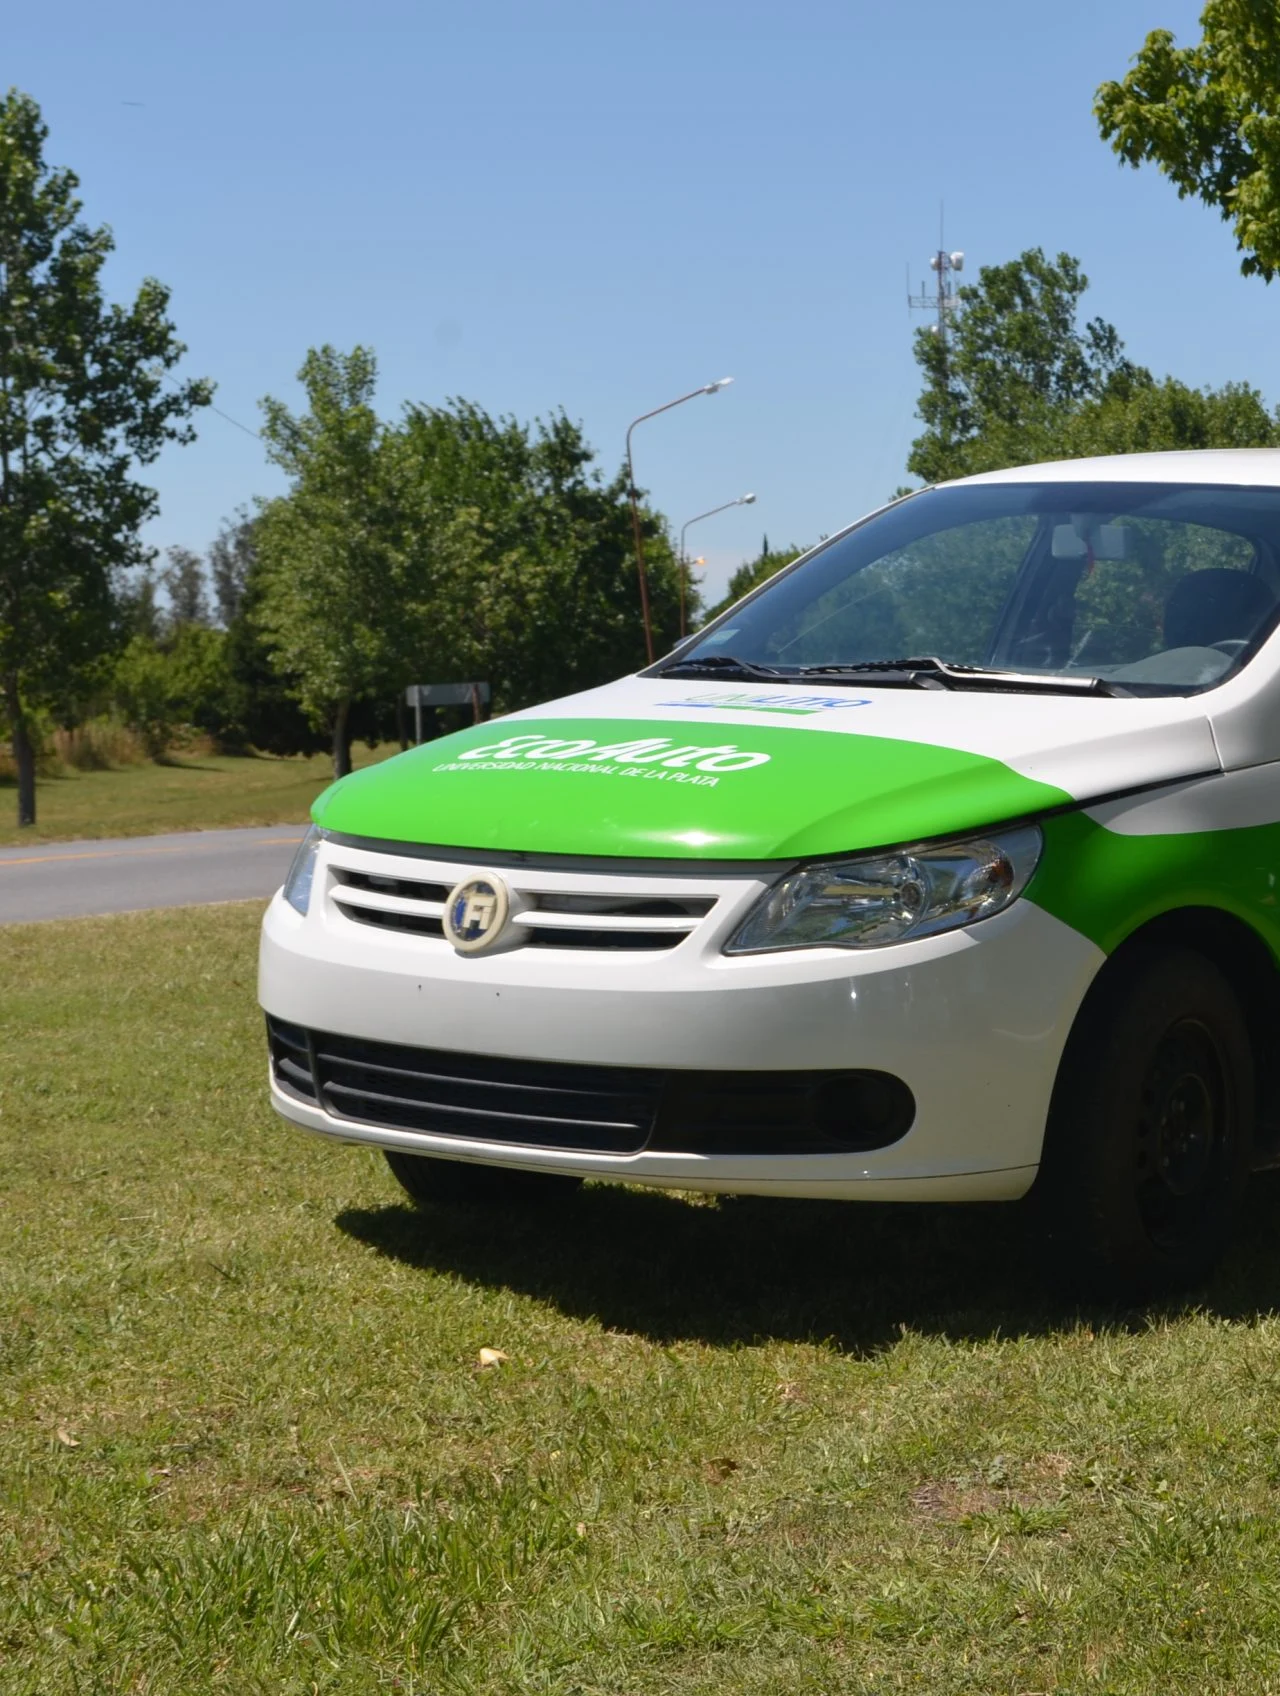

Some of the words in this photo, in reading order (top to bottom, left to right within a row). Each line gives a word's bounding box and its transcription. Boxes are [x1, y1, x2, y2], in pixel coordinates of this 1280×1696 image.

[457, 734, 771, 772] EcoAuto
[432, 761, 537, 772] UNIVERSIDAD
[533, 762, 619, 775] NACIONAL
[618, 766, 648, 777] DE
[644, 769, 669, 780] LA
[665, 772, 720, 788] PLATA
